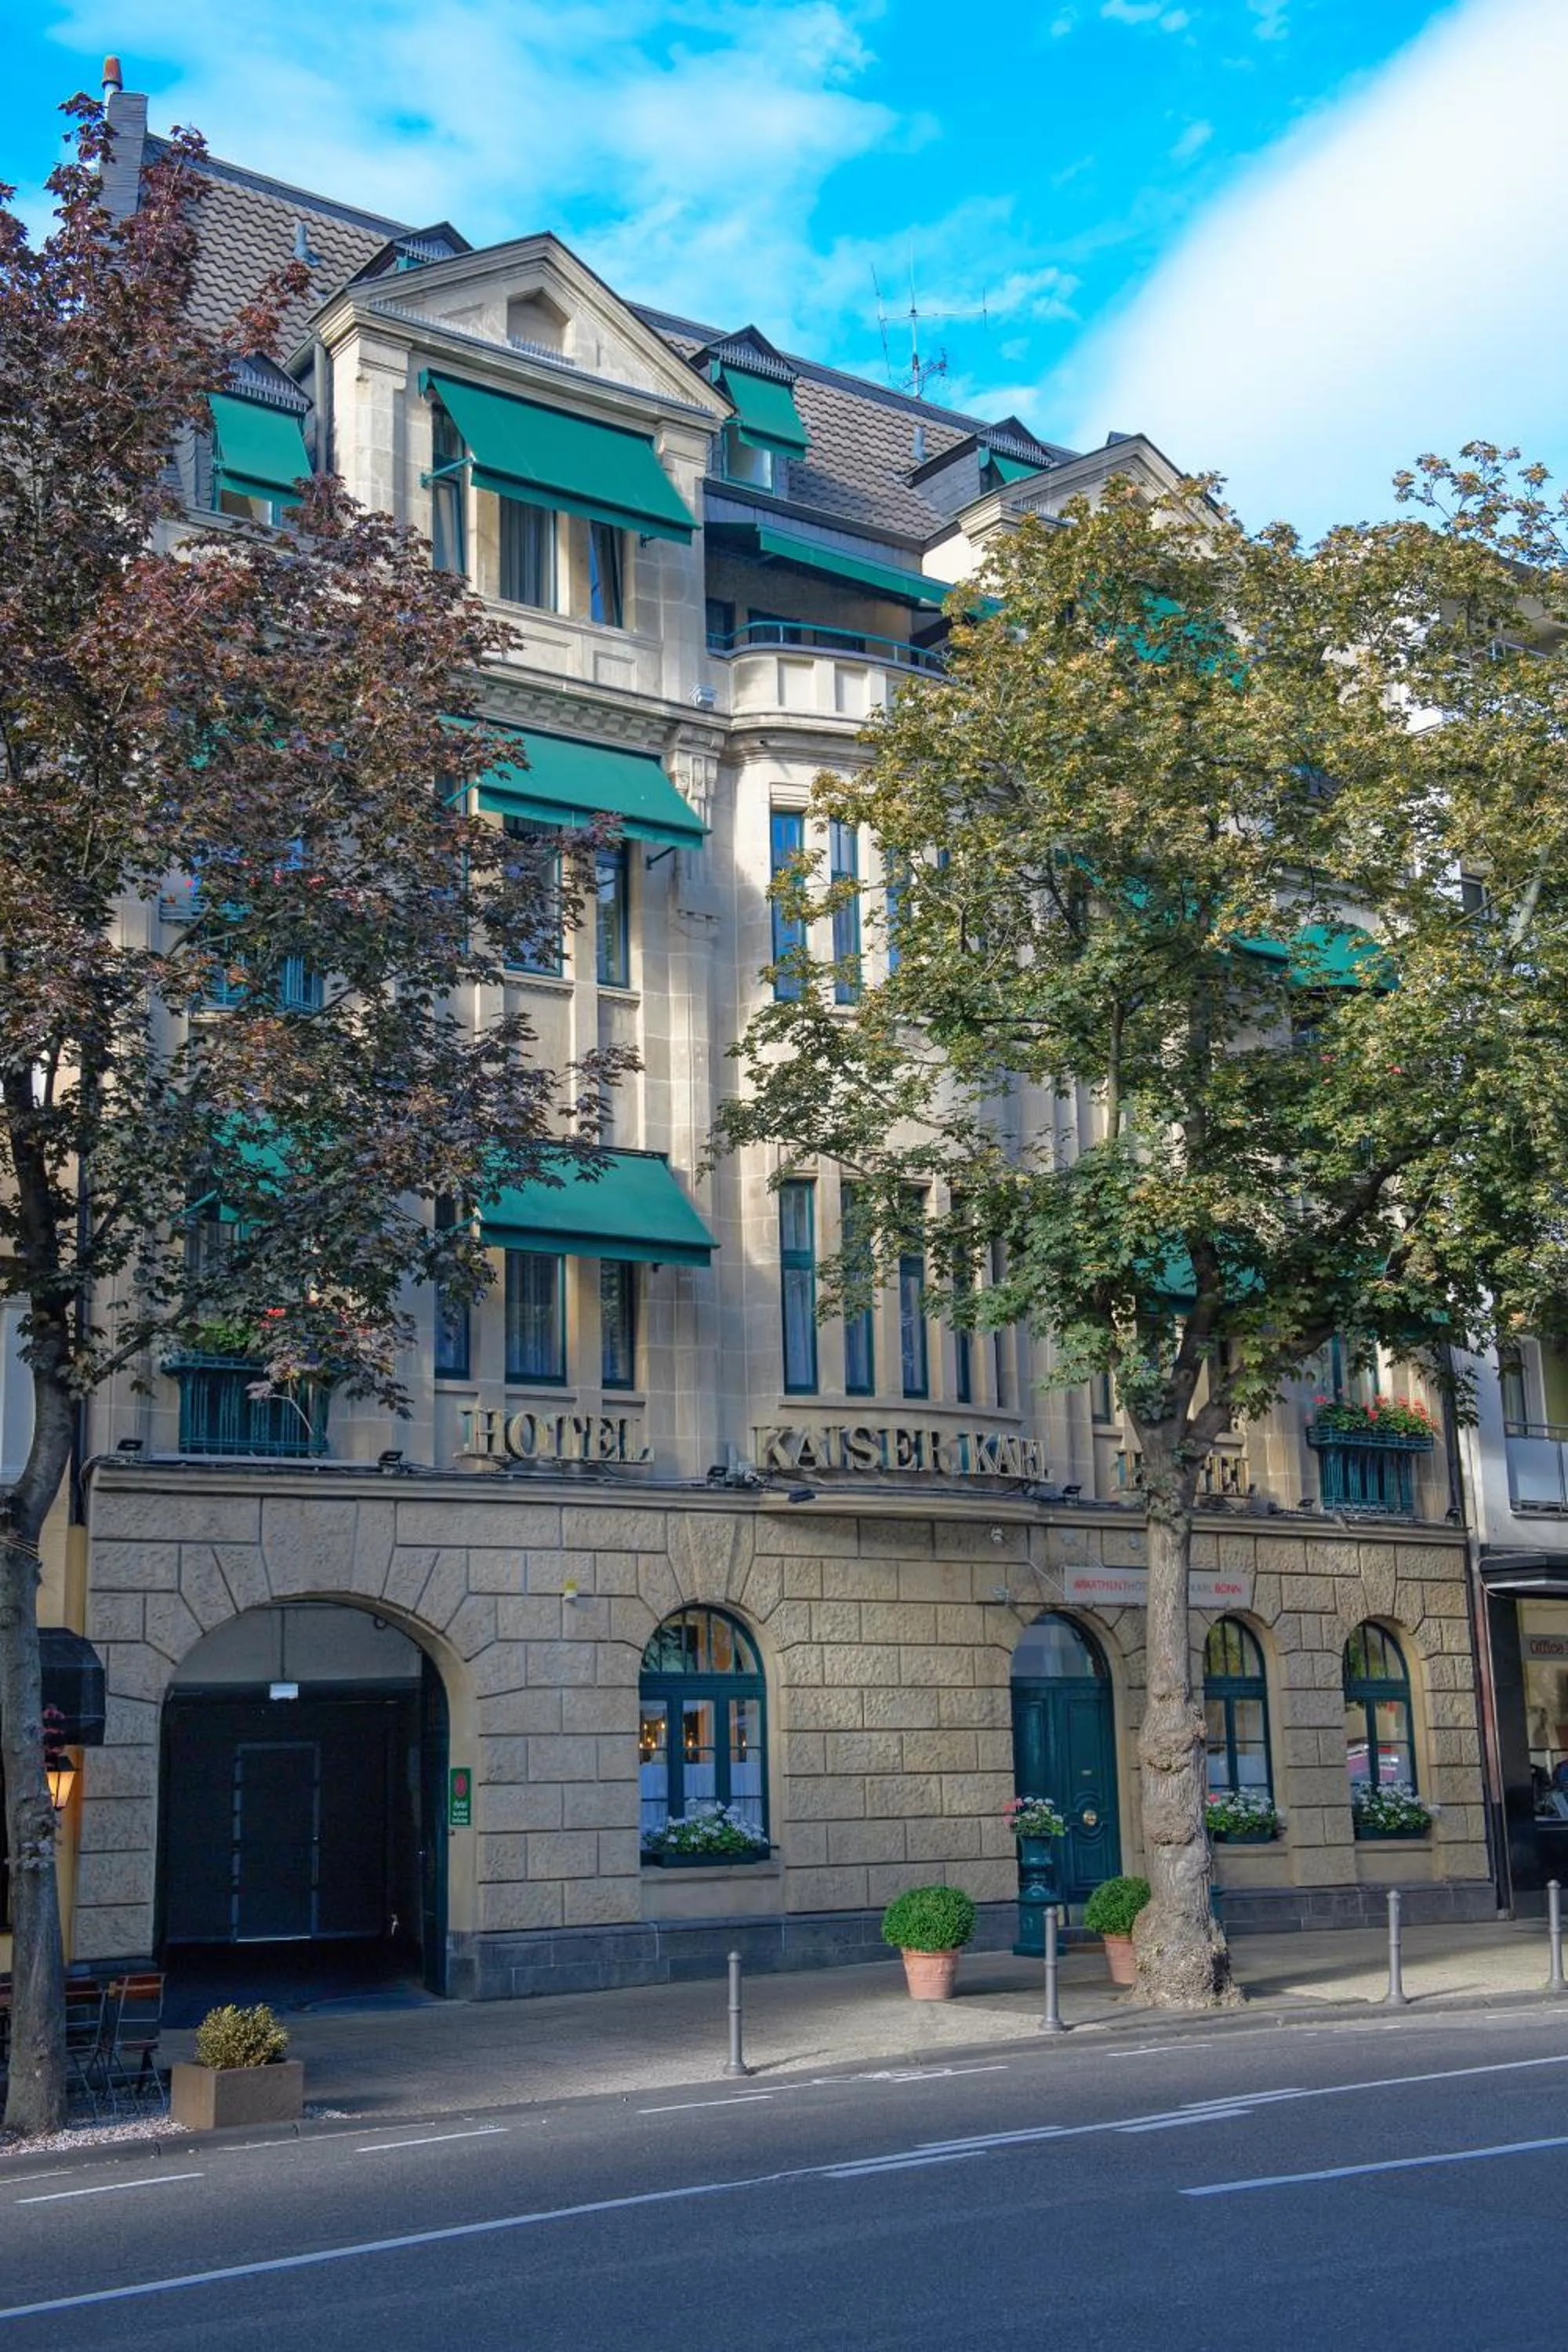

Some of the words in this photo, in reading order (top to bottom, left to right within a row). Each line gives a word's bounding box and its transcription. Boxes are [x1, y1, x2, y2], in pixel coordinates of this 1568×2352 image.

[459, 1408, 652, 1462] HOTEL
[752, 1425, 954, 1472] KAISER
[957, 1430, 1054, 1482] KARL
[1214, 1581, 1242, 1594] BONN
[1530, 1639, 1564, 1655] Office
